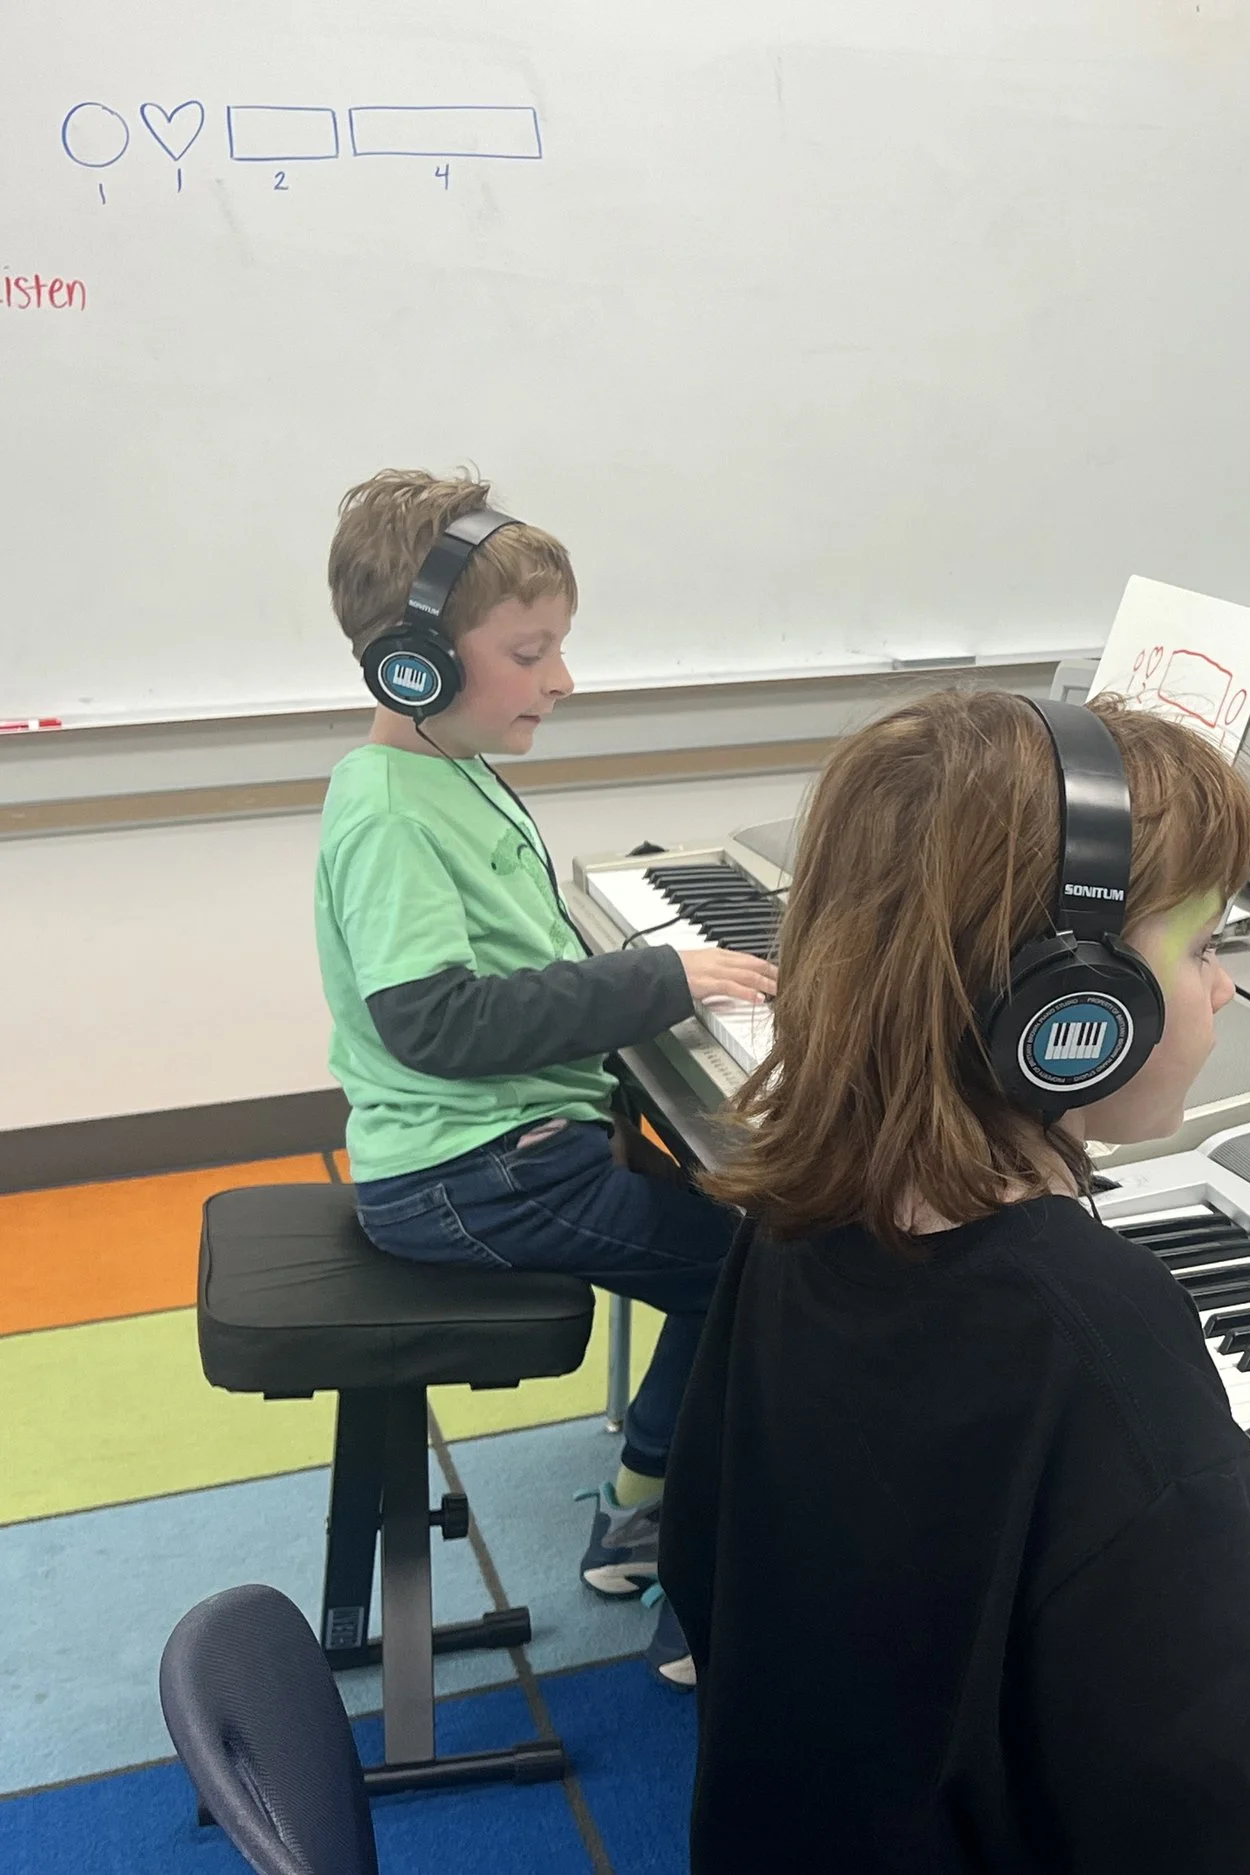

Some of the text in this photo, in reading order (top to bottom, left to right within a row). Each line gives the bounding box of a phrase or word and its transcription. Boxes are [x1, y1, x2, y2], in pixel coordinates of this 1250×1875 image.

[273, 171, 289, 191] 2
[435, 164, 450, 190] 4
[1064, 883, 1124, 901] SONITUM
